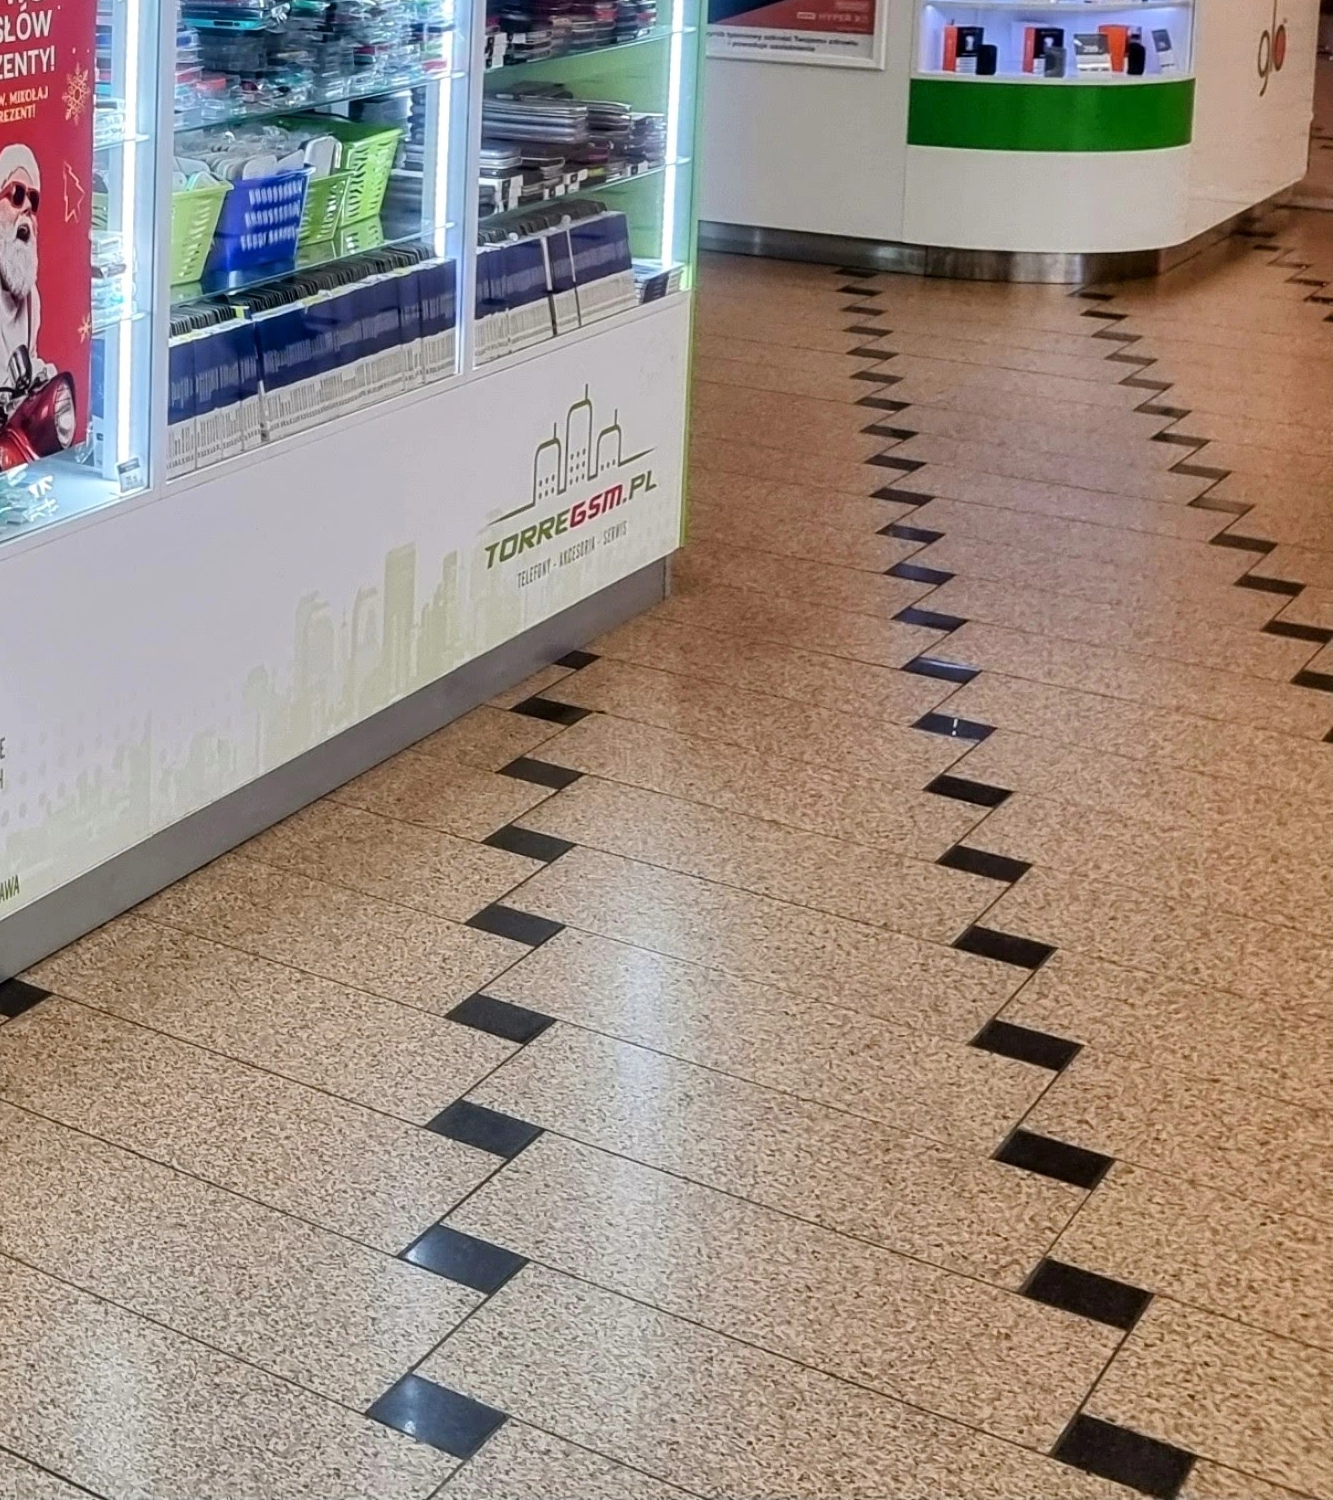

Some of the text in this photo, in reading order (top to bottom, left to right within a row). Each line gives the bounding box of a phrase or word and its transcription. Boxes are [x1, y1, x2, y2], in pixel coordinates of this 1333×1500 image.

[9, 85, 49, 105] MIKOŁAJ
[484, 470, 657, 570] TORREGSM.PL
[517, 557, 551, 589] TELEFONY
[559, 536, 595, 567] AKCESORIA
